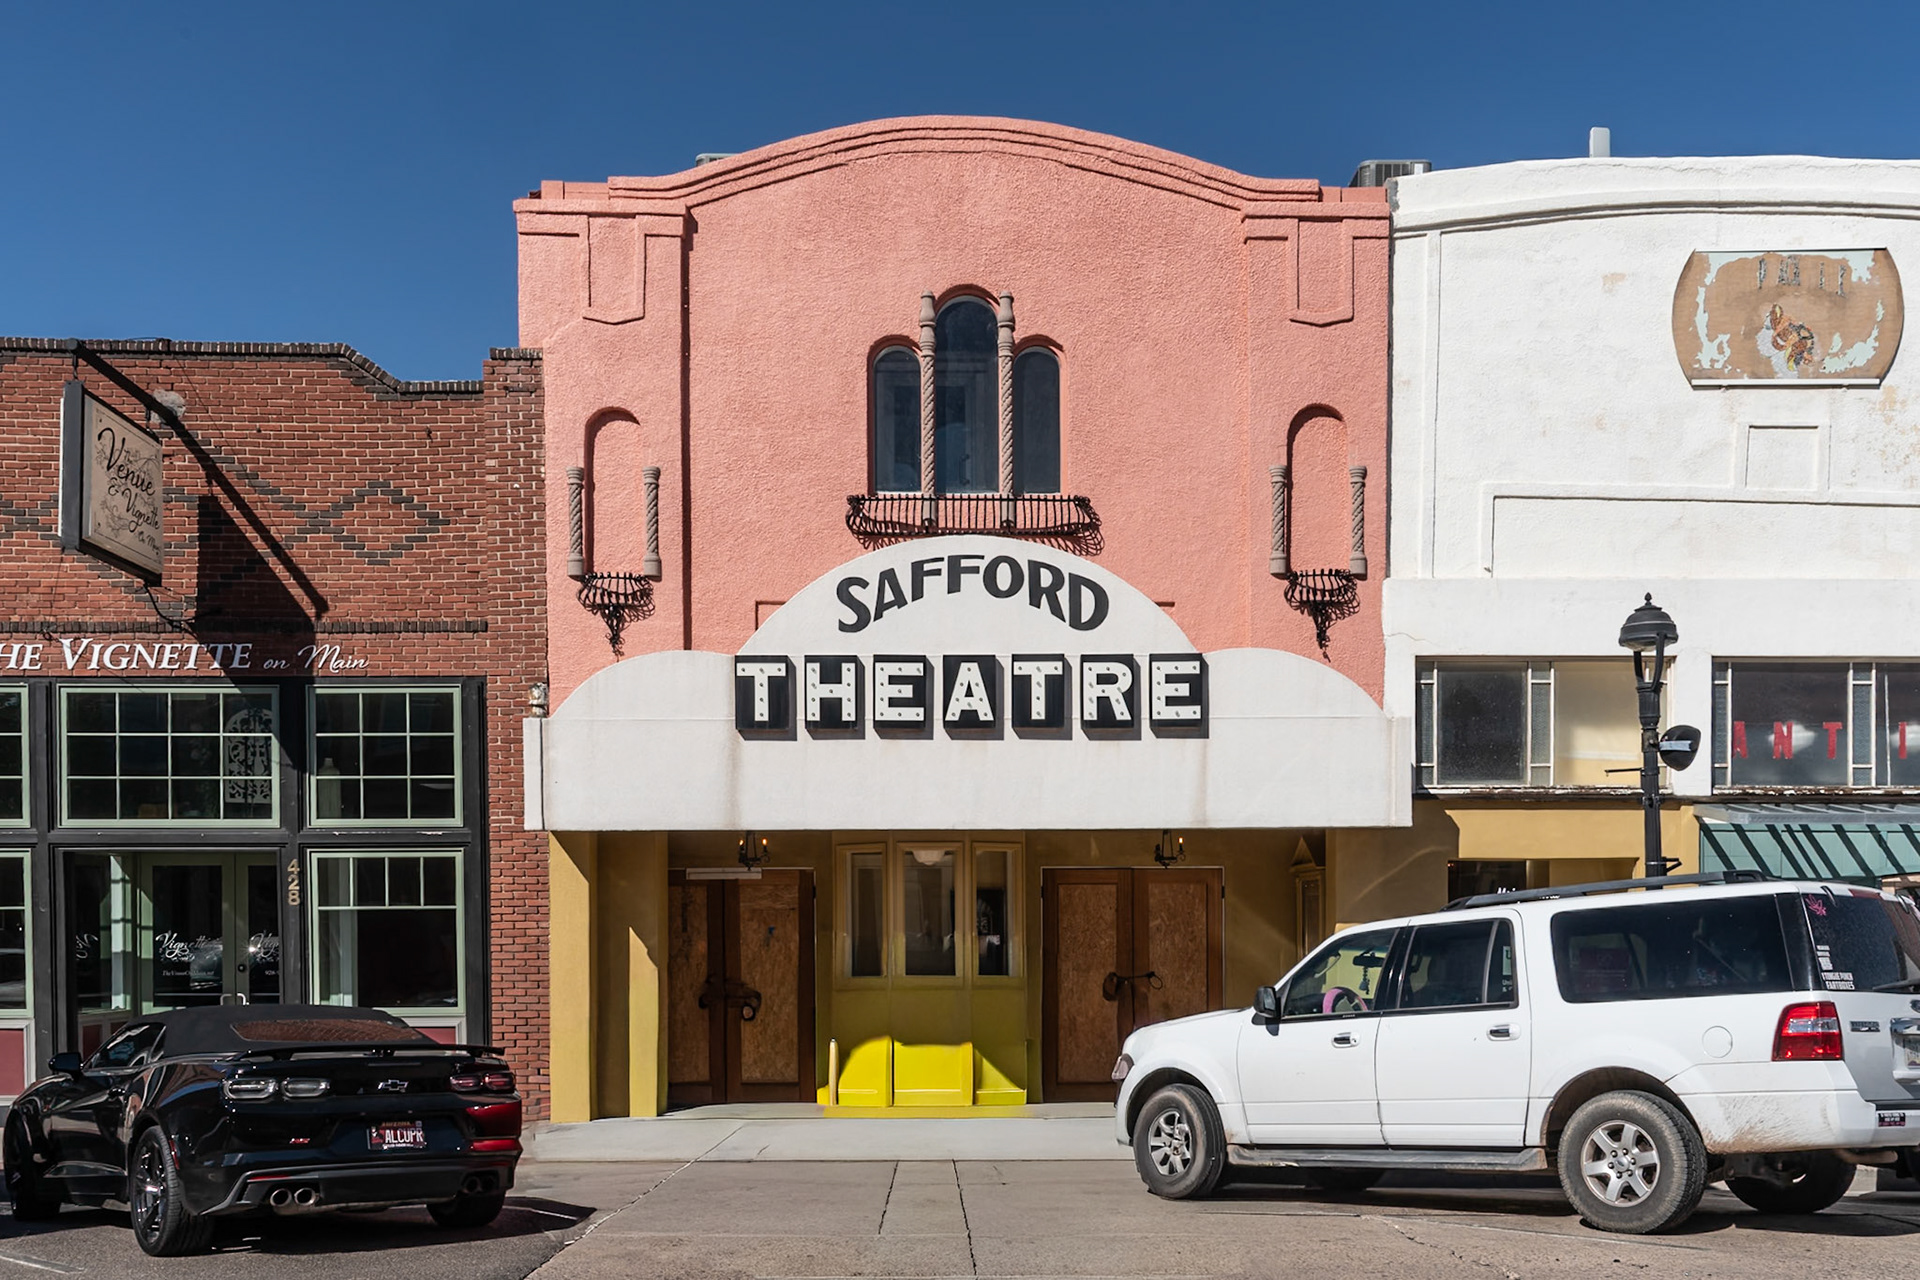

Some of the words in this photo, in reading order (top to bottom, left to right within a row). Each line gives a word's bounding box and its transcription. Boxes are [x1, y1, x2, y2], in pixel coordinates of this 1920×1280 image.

[98, 428, 155, 496] Venue
[122, 487, 159, 533] Vignette
[836, 555, 1109, 633] SAFFORD
[59, 638, 253, 671] VIGNETTE
[263, 657, 290, 670] on
[297, 643, 370, 674] Main
[736, 660, 1202, 722] THEATRE
[287, 858, 300, 906] 428
